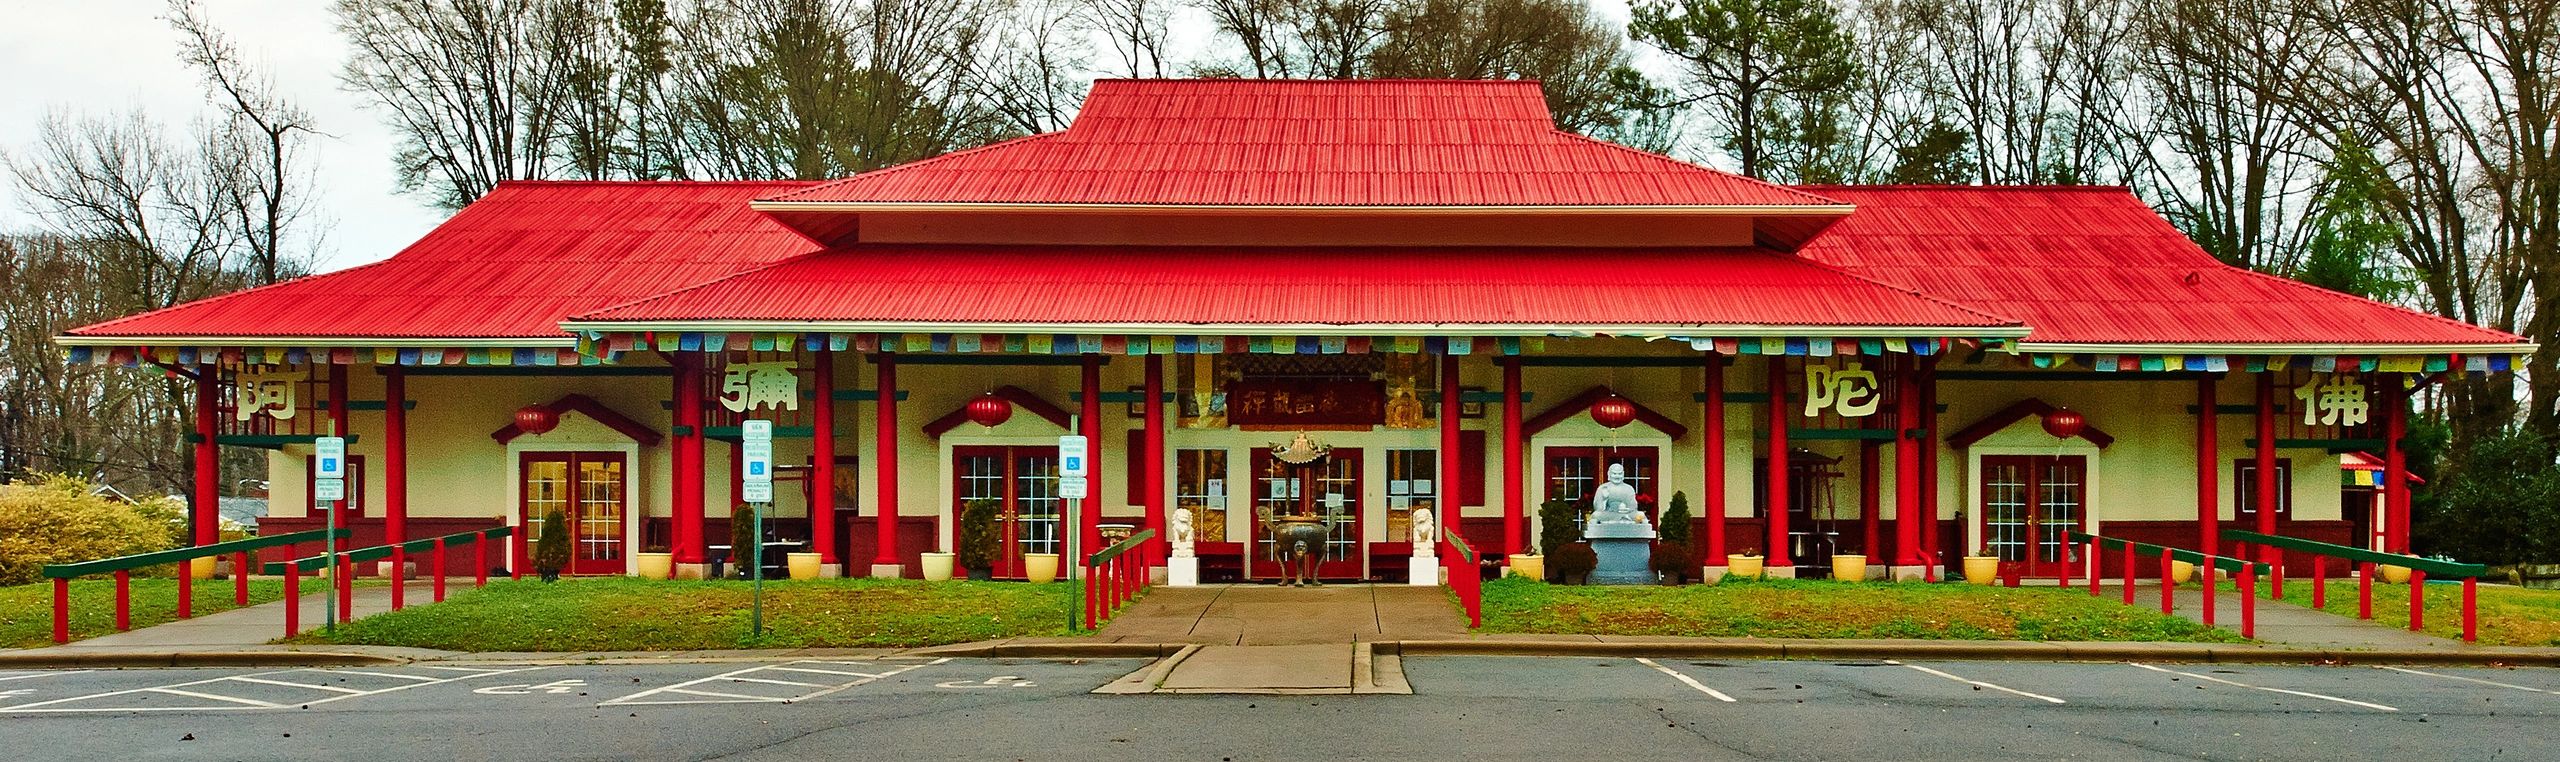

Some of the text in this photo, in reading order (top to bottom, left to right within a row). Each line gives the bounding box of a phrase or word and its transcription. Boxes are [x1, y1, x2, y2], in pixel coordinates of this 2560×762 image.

[236, 371, 307, 420] 阿
[720, 361, 798, 413] 彌
[1804, 362, 1881, 417] 陀
[2294, 373, 2369, 426] 佛
